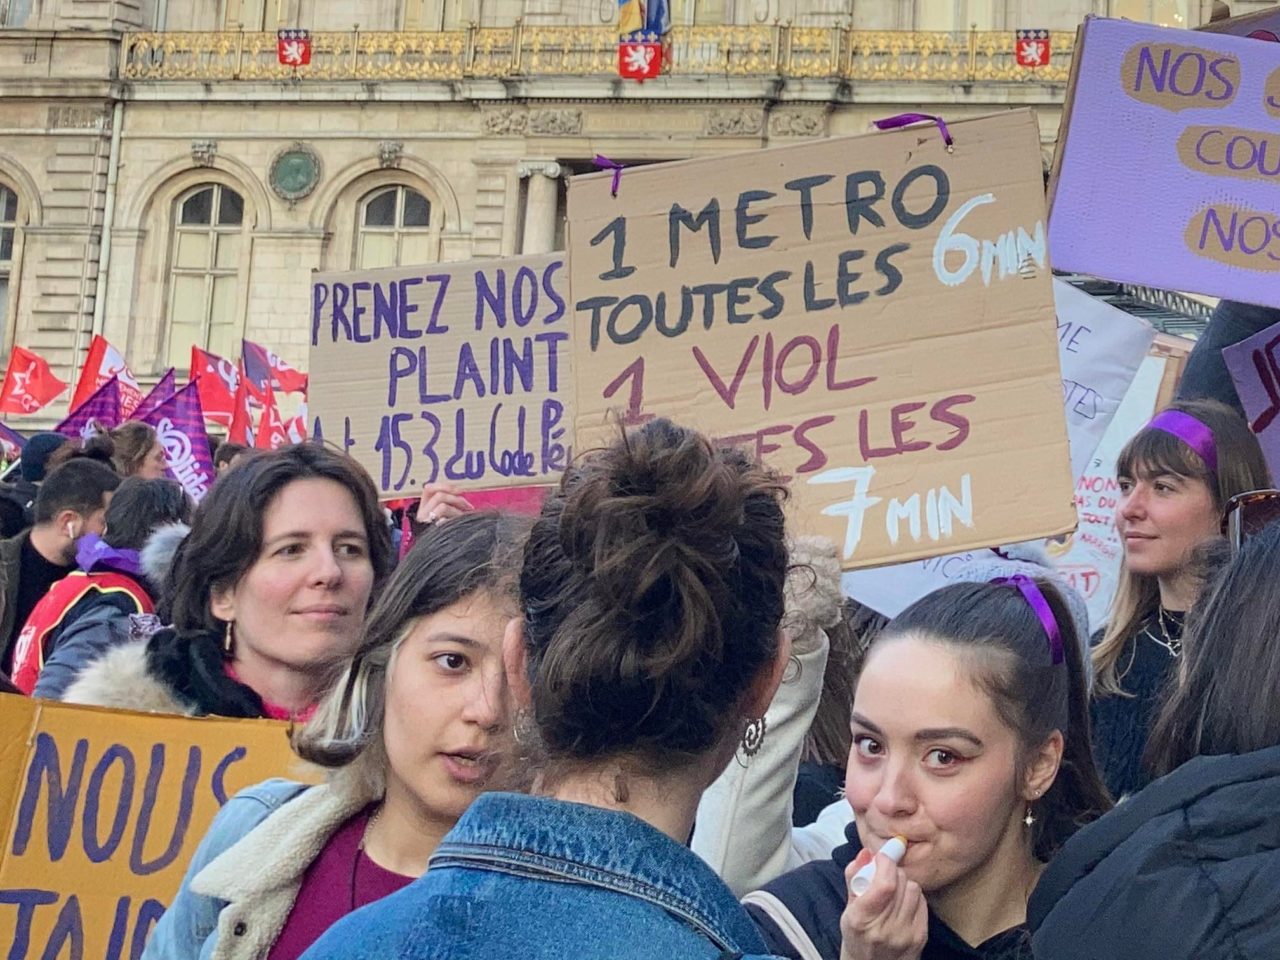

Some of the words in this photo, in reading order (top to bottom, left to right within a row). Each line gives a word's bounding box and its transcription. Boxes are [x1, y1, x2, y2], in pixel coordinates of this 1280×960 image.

[1134, 47, 1235, 101] NOS
[590, 215, 637, 280] 1
[669, 164, 950, 269] METRO
[312, 274, 452, 346] PRENEZ
[475, 261, 566, 331] NOS
[575, 269, 793, 353] TOUTES
[803, 242, 910, 313] LES
[388, 331, 569, 407] PLAINT
[603, 355, 657, 425] 1
[692, 323, 876, 411] VIOL
[859, 394, 976, 462] LES
